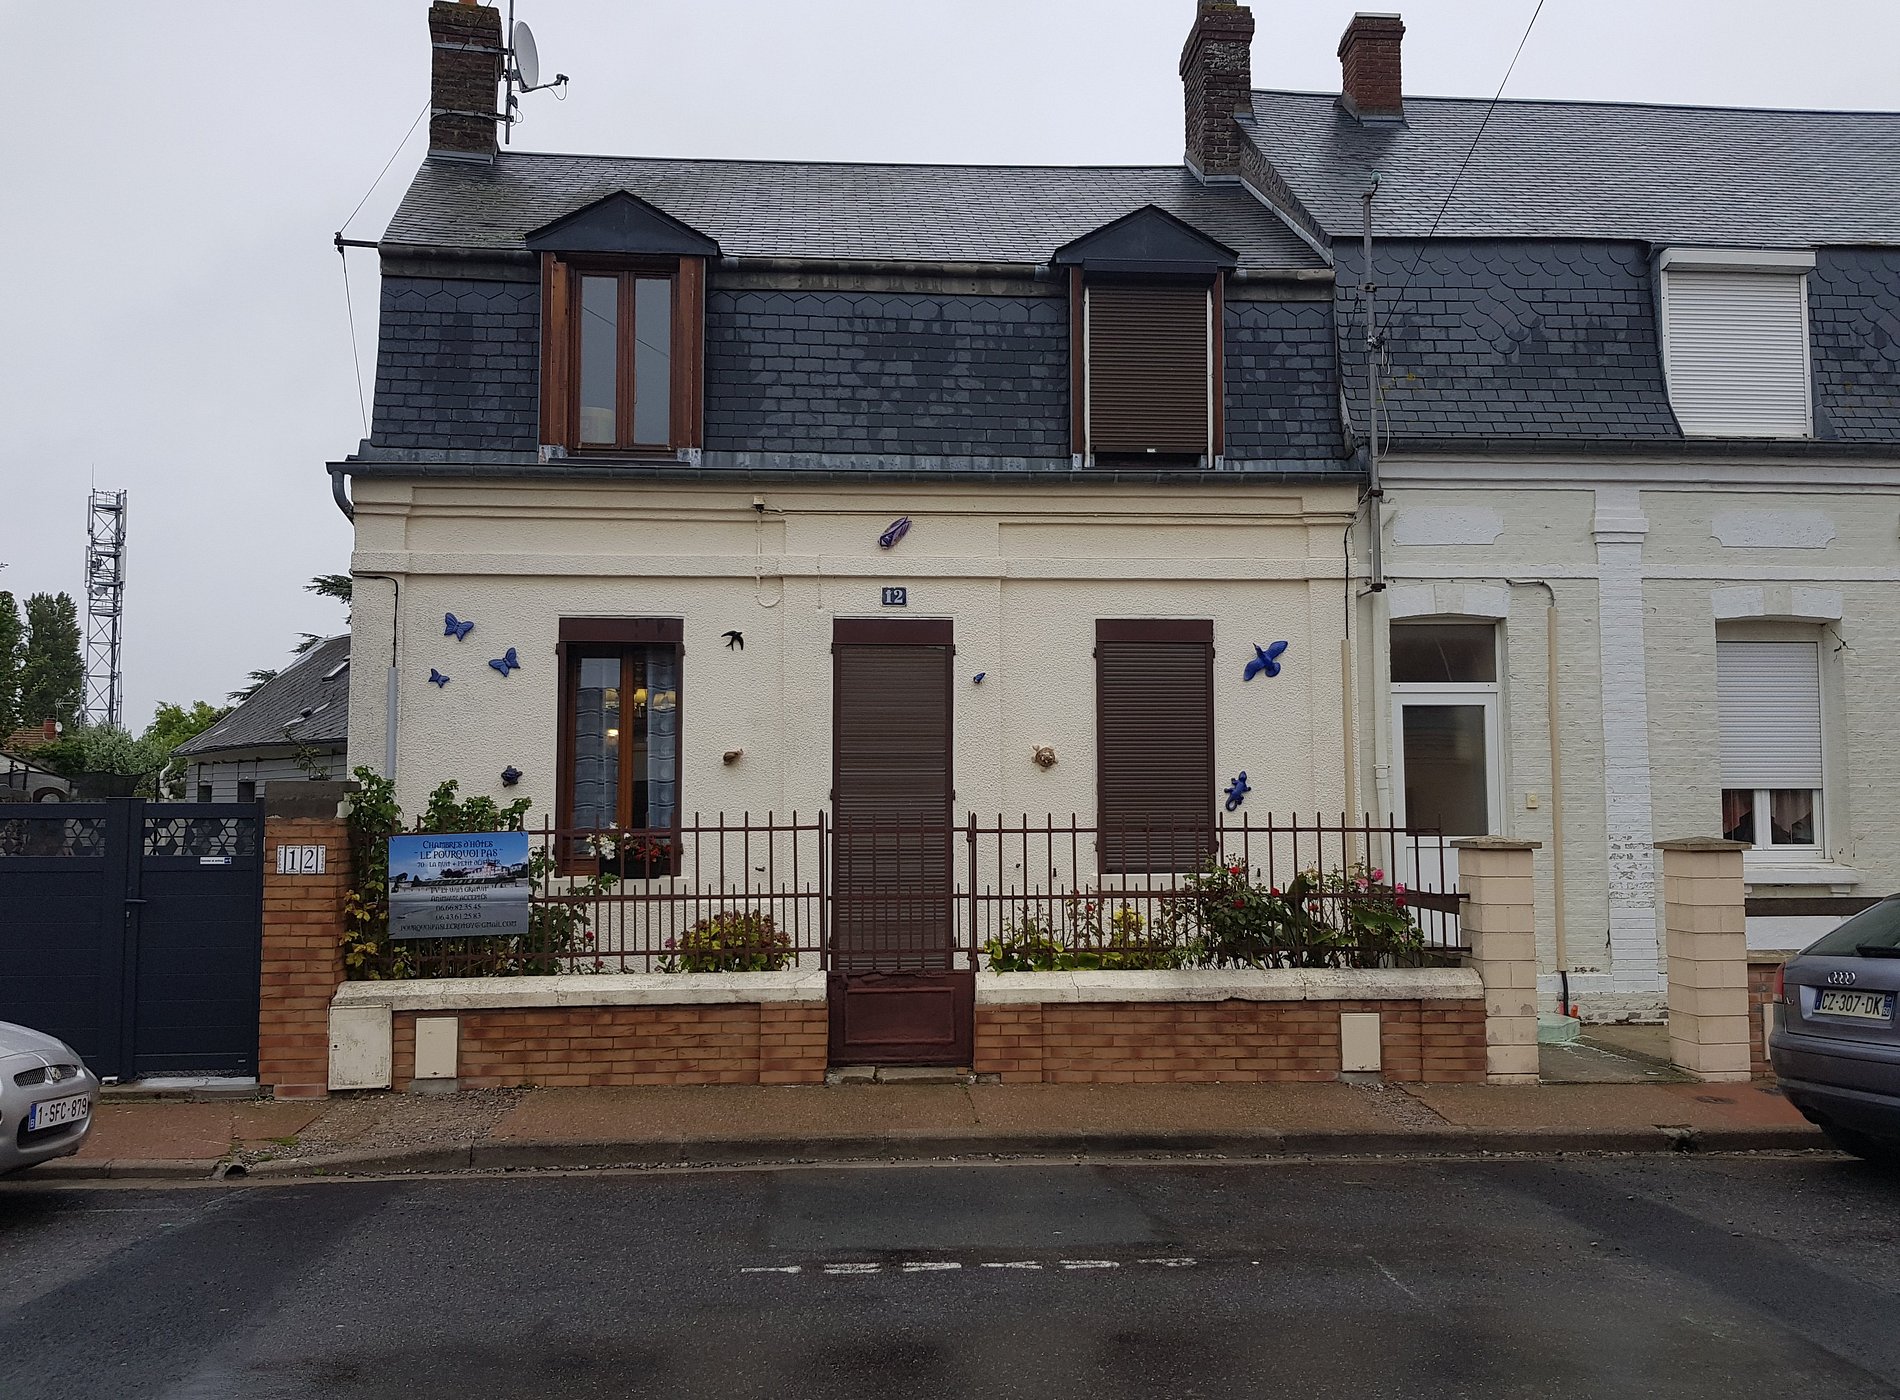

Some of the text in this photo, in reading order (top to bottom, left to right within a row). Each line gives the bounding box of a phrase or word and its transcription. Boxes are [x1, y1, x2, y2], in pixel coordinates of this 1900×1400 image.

[885, 589, 903, 603] 12
[288, 849, 314, 871] 12
[433, 849, 479, 860] POURQUOI
[38, 1097, 87, 1125] 1-SFC-879
